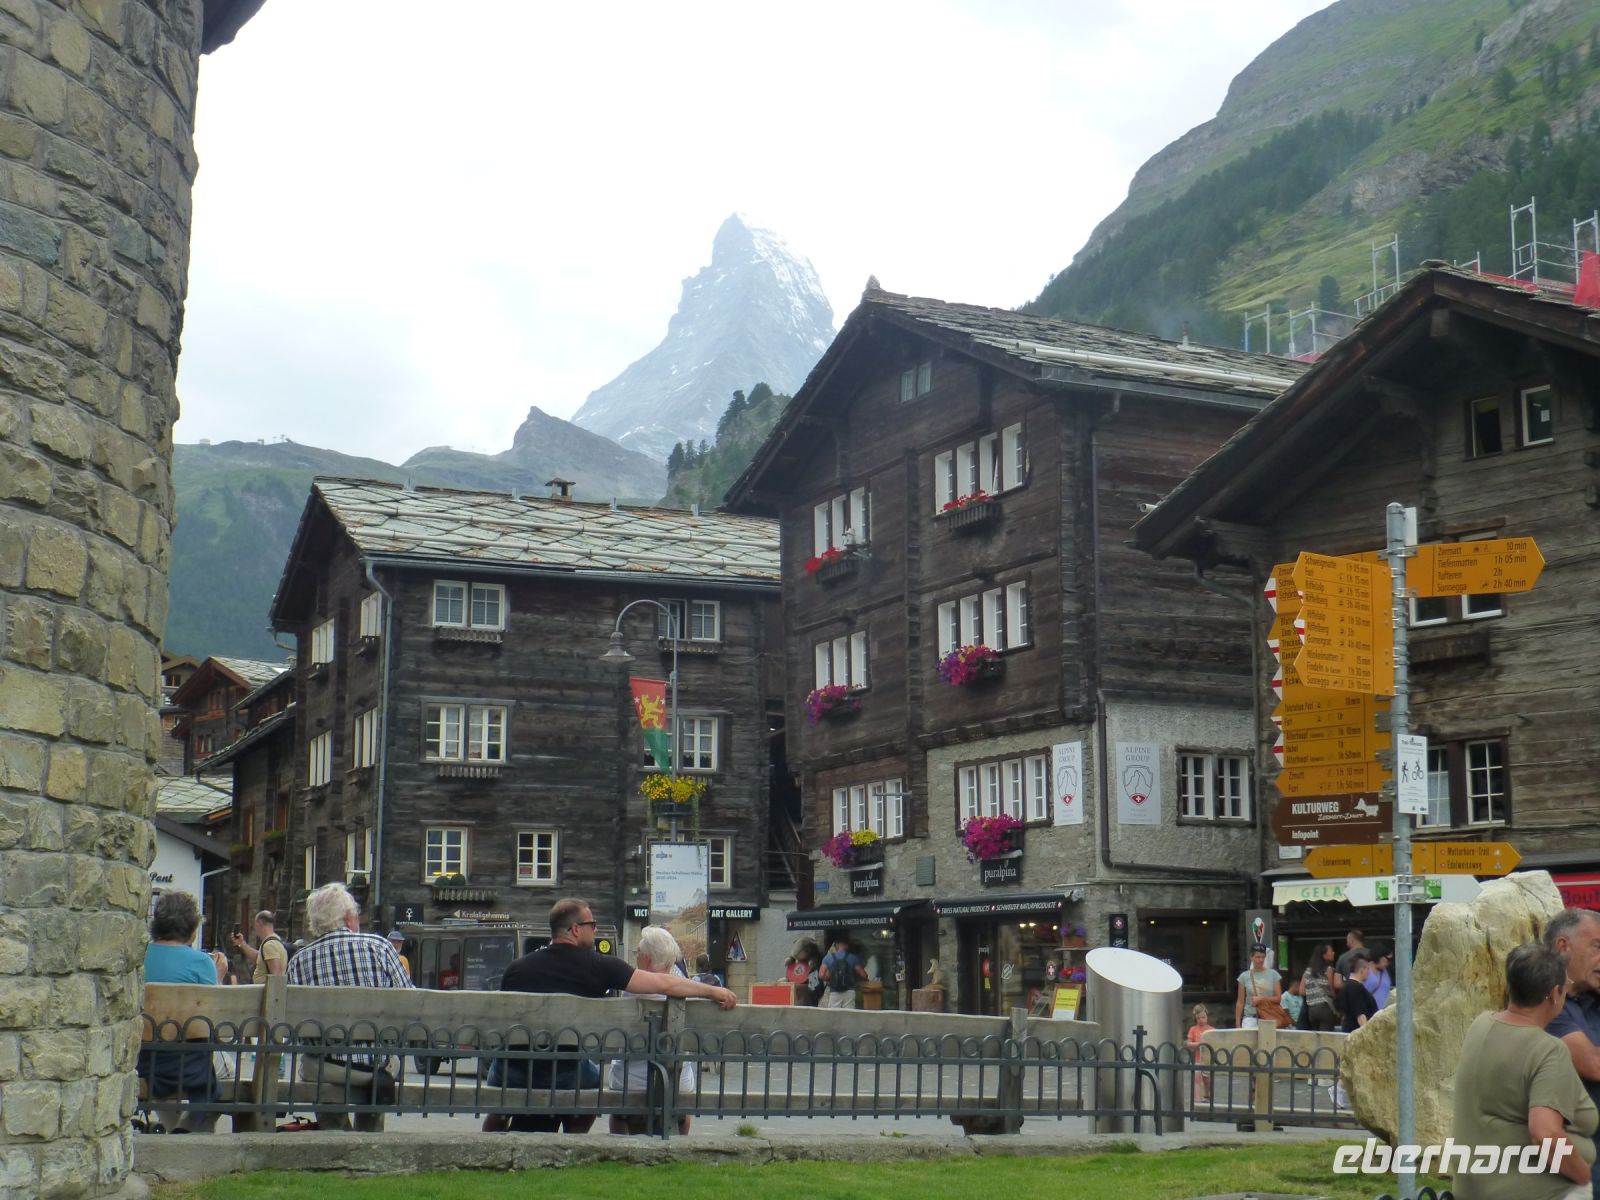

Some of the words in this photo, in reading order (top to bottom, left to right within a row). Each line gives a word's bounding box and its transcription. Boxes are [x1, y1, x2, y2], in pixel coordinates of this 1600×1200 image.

[1438, 546, 1462, 555] Zermatt
[1514, 542, 1526, 550] min
[1437, 583, 1467, 593] Sunnegga
[1514, 579, 1526, 587] min
[1125, 746, 1151, 754] ALPINE
[1125, 754, 1150, 762] GROUP
[1292, 801, 1339, 815] KULTURWEG
[1292, 830, 1319, 840] Infopoint
[150, 872, 173, 884] Pont
[984, 865, 1017, 882] puralpina
[853, 877, 879, 893] puralpina
[1301, 885, 1347, 898] GELA
[1562, 889, 1600, 905] Bout
[634, 908, 649, 917] VICT
[711, 909, 724, 918] ART
[725, 909, 753, 918] GALLERY
